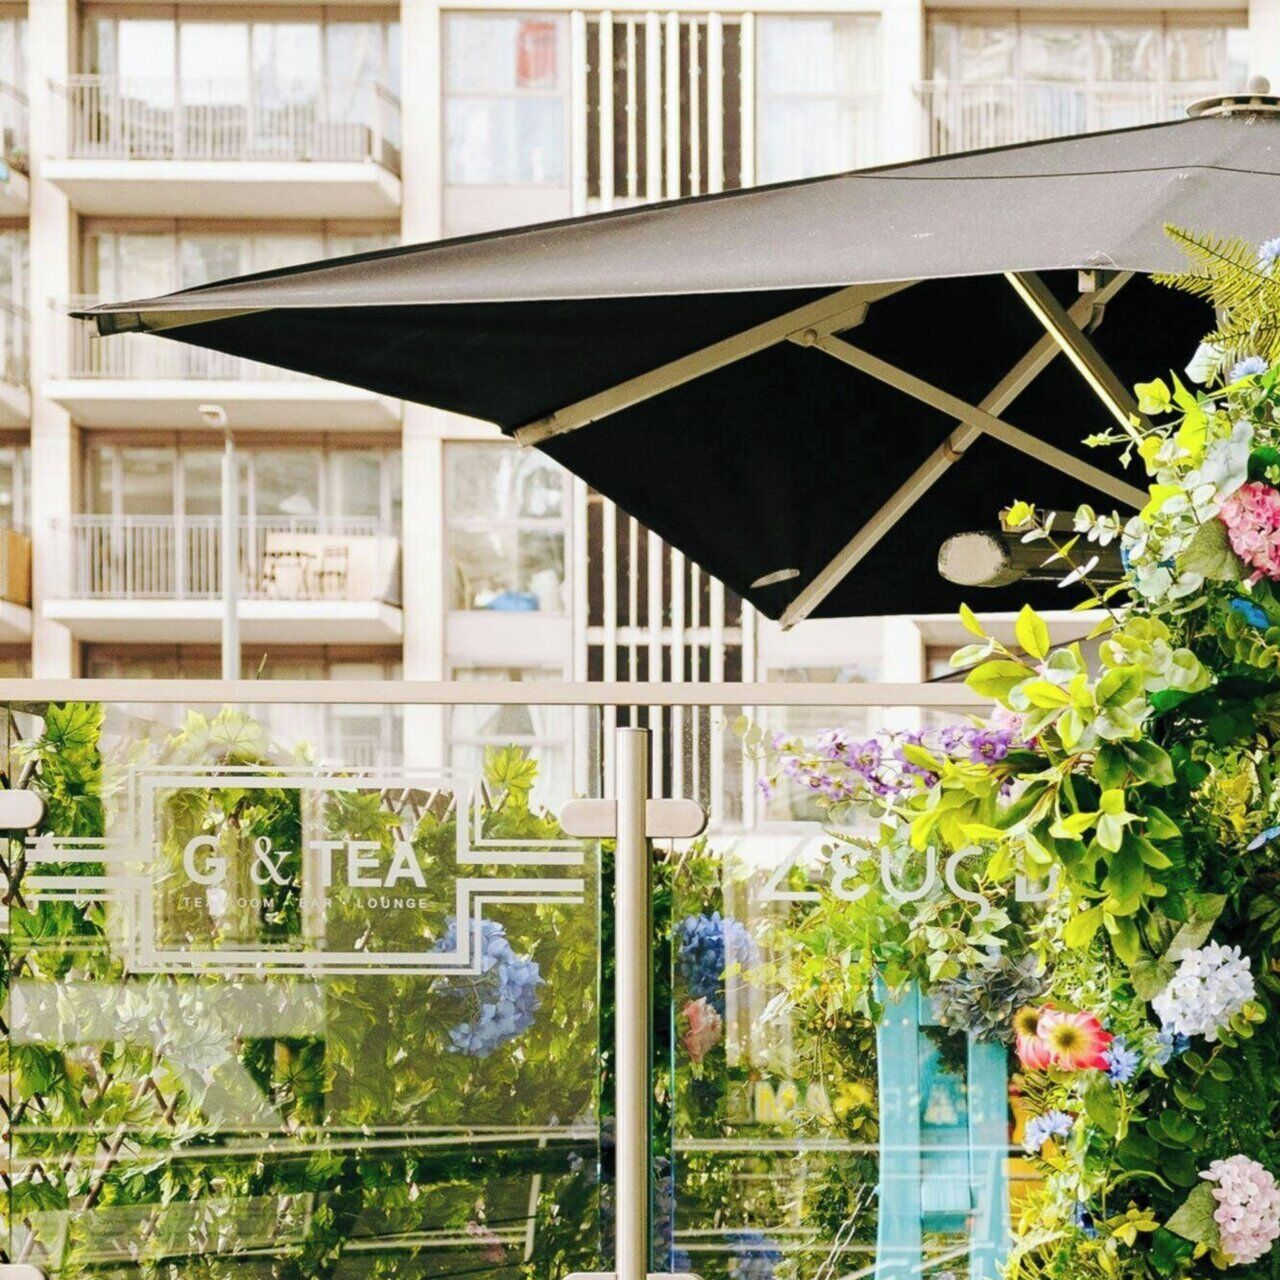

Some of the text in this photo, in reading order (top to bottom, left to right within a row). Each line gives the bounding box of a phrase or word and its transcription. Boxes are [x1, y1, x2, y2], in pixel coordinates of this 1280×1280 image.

[182, 834, 428, 888] G & TEA
[183, 896, 216, 908] TE
[226, 896, 275, 909] OOM
[356, 896, 429, 909] LOUNGE
